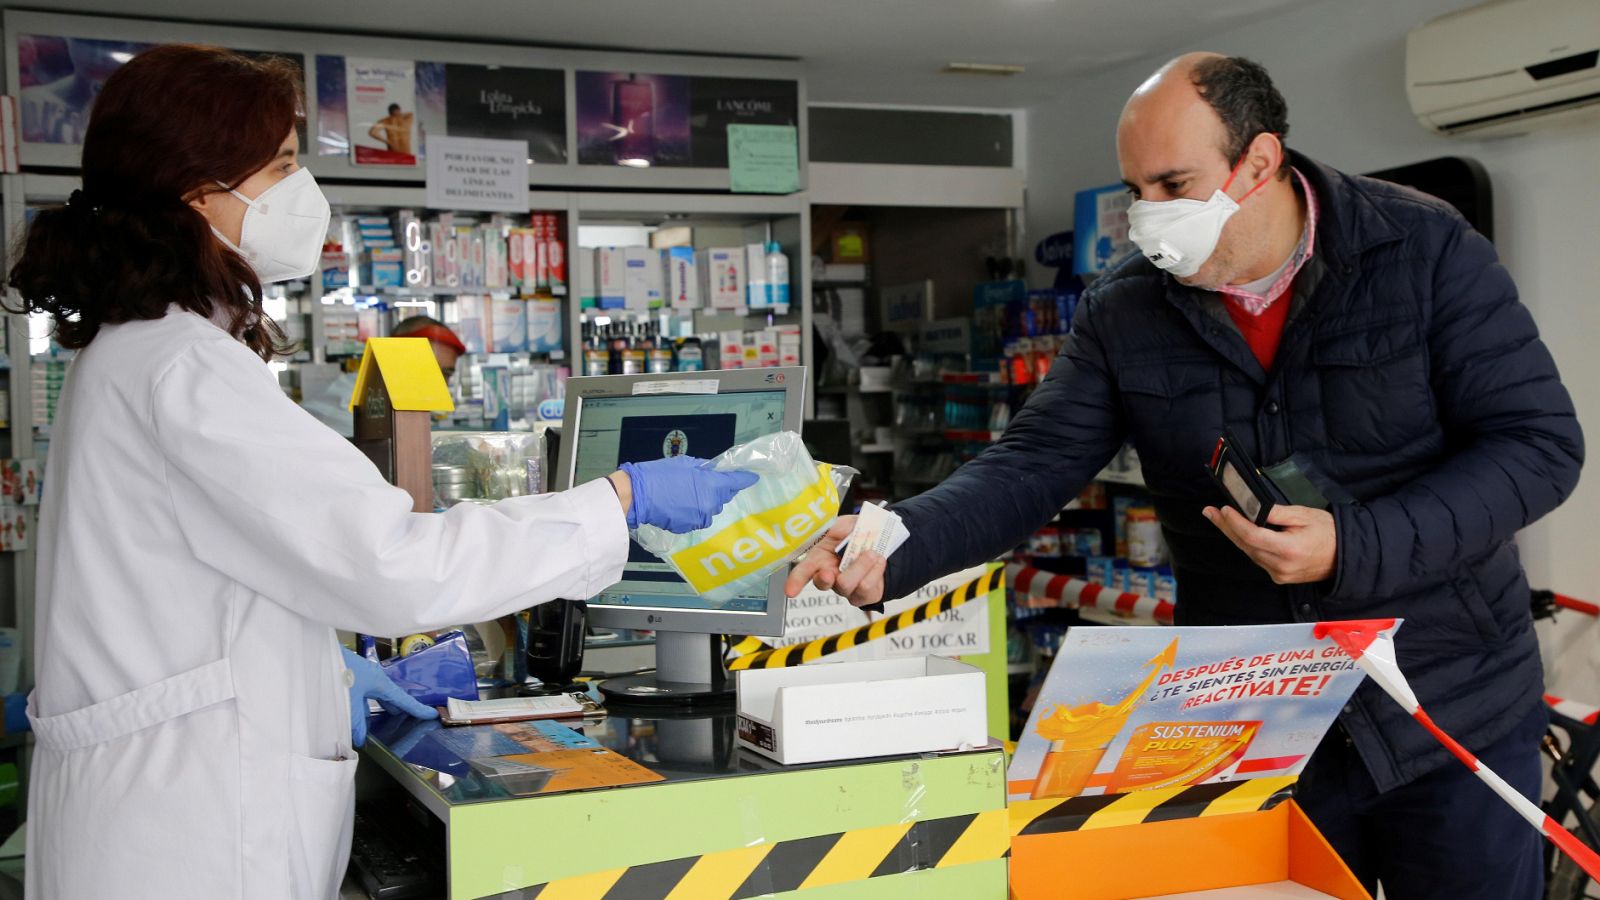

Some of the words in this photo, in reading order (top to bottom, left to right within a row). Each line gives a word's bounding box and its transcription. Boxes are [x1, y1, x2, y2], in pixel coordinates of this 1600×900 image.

[480, 89, 513, 104] Lolita
[489, 100, 543, 120] Lempicka
[501, 156, 514, 165] NO
[448, 165, 477, 174] PASAR
[479, 167, 490, 175] DE
[493, 168, 511, 176] LAS
[445, 188, 514, 200] DELIMITANTES
[1150, 253, 1164, 262] 3M
[916, 584, 949, 599] POR
[814, 613, 843, 627] CON
[889, 635, 914, 650] NO
[919, 631, 977, 650] TOCAR
[1157, 656, 1244, 686] DESPUÉS
[1248, 653, 1276, 668] DE
[1278, 648, 1314, 665] UNA
[1321, 645, 1349, 659] GR
[1150, 684, 1183, 702] ¿TE
[1185, 670, 1255, 694] SIENTES
[1258, 665, 1288, 680] SIN
[1289, 657, 1360, 675] ENERGÍA
[1180, 673, 1333, 711] ¡REACTÍVATE!
[1149, 724, 1246, 740] SUSTENIUM
[1143, 738, 1197, 752] PLUS
